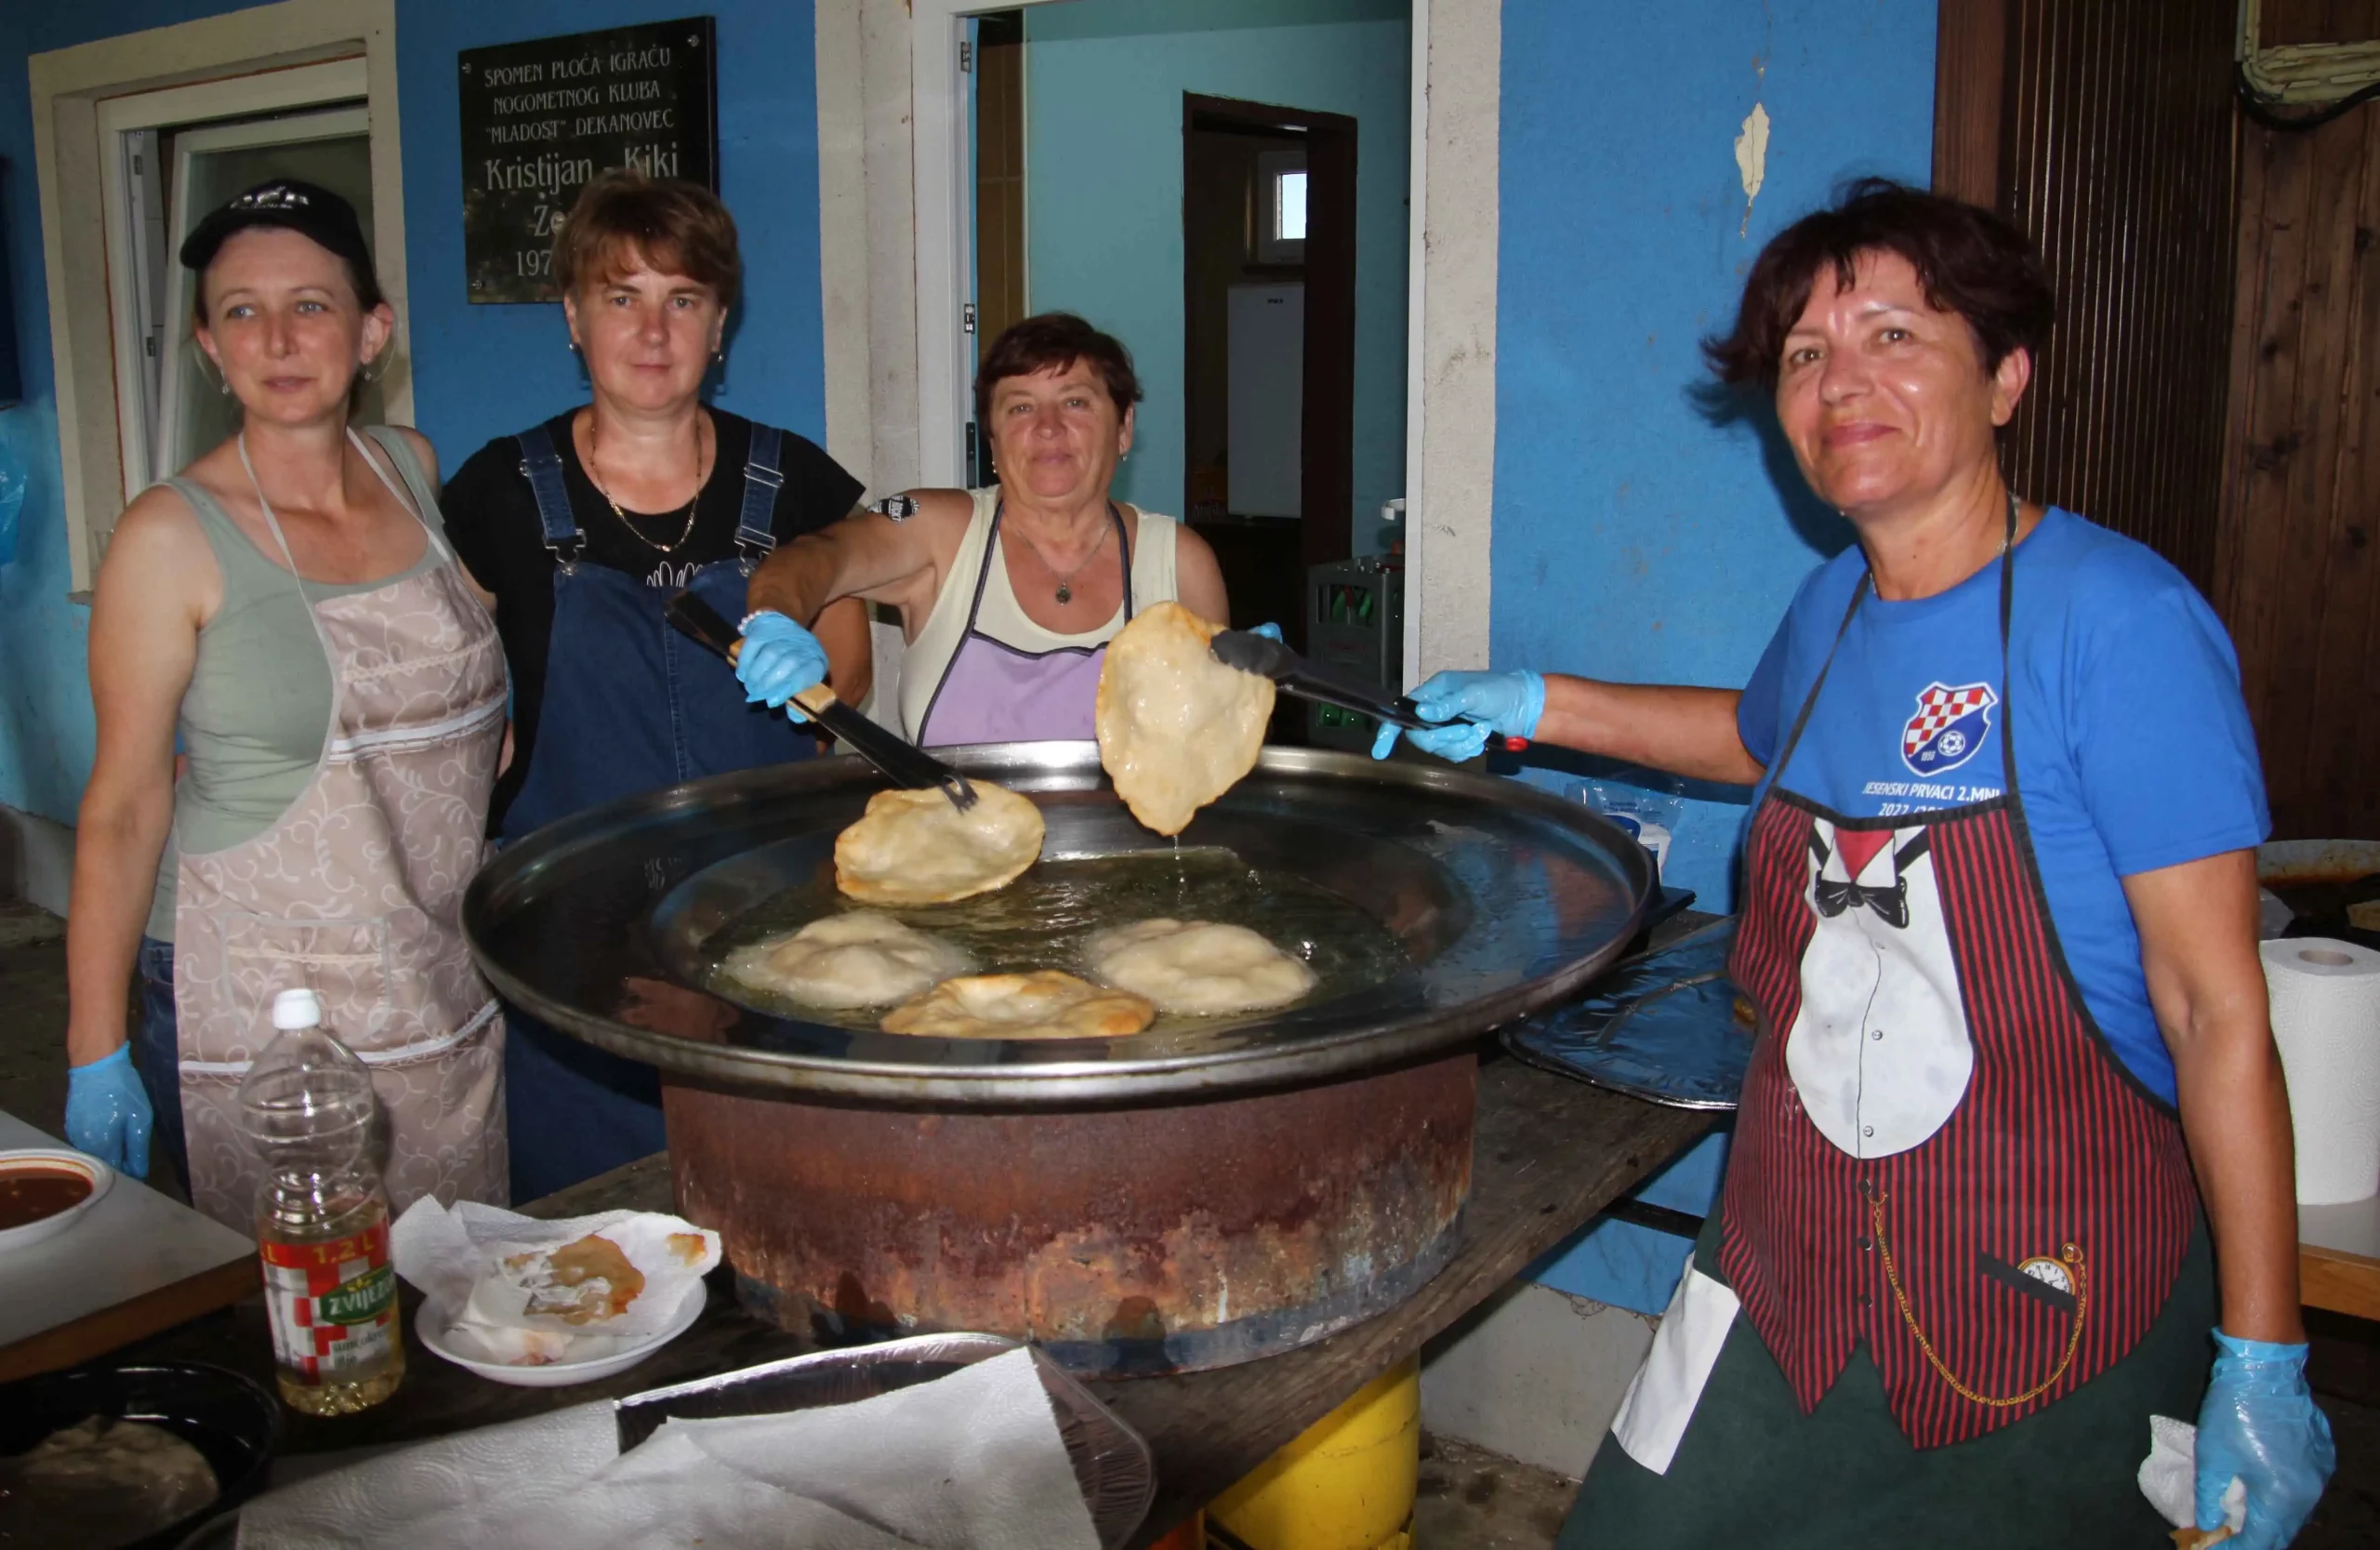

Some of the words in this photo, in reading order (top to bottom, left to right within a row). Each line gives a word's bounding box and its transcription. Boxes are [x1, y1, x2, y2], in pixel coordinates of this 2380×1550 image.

[484, 63, 542, 87] SPOMEN
[551, 53, 601, 80] PLOČA
[494, 86, 599, 115] NOGOMETNOG
[609, 80, 660, 103] KLUBA
[485, 120, 566, 144] "MLADOST"
[575, 108, 675, 137] DEKANOVEC
[486, 152, 592, 195] Kristijan
[625, 141, 678, 179] Kiki
[516, 249, 555, 276] 197
[1909, 783, 1955, 801] PRVACI
